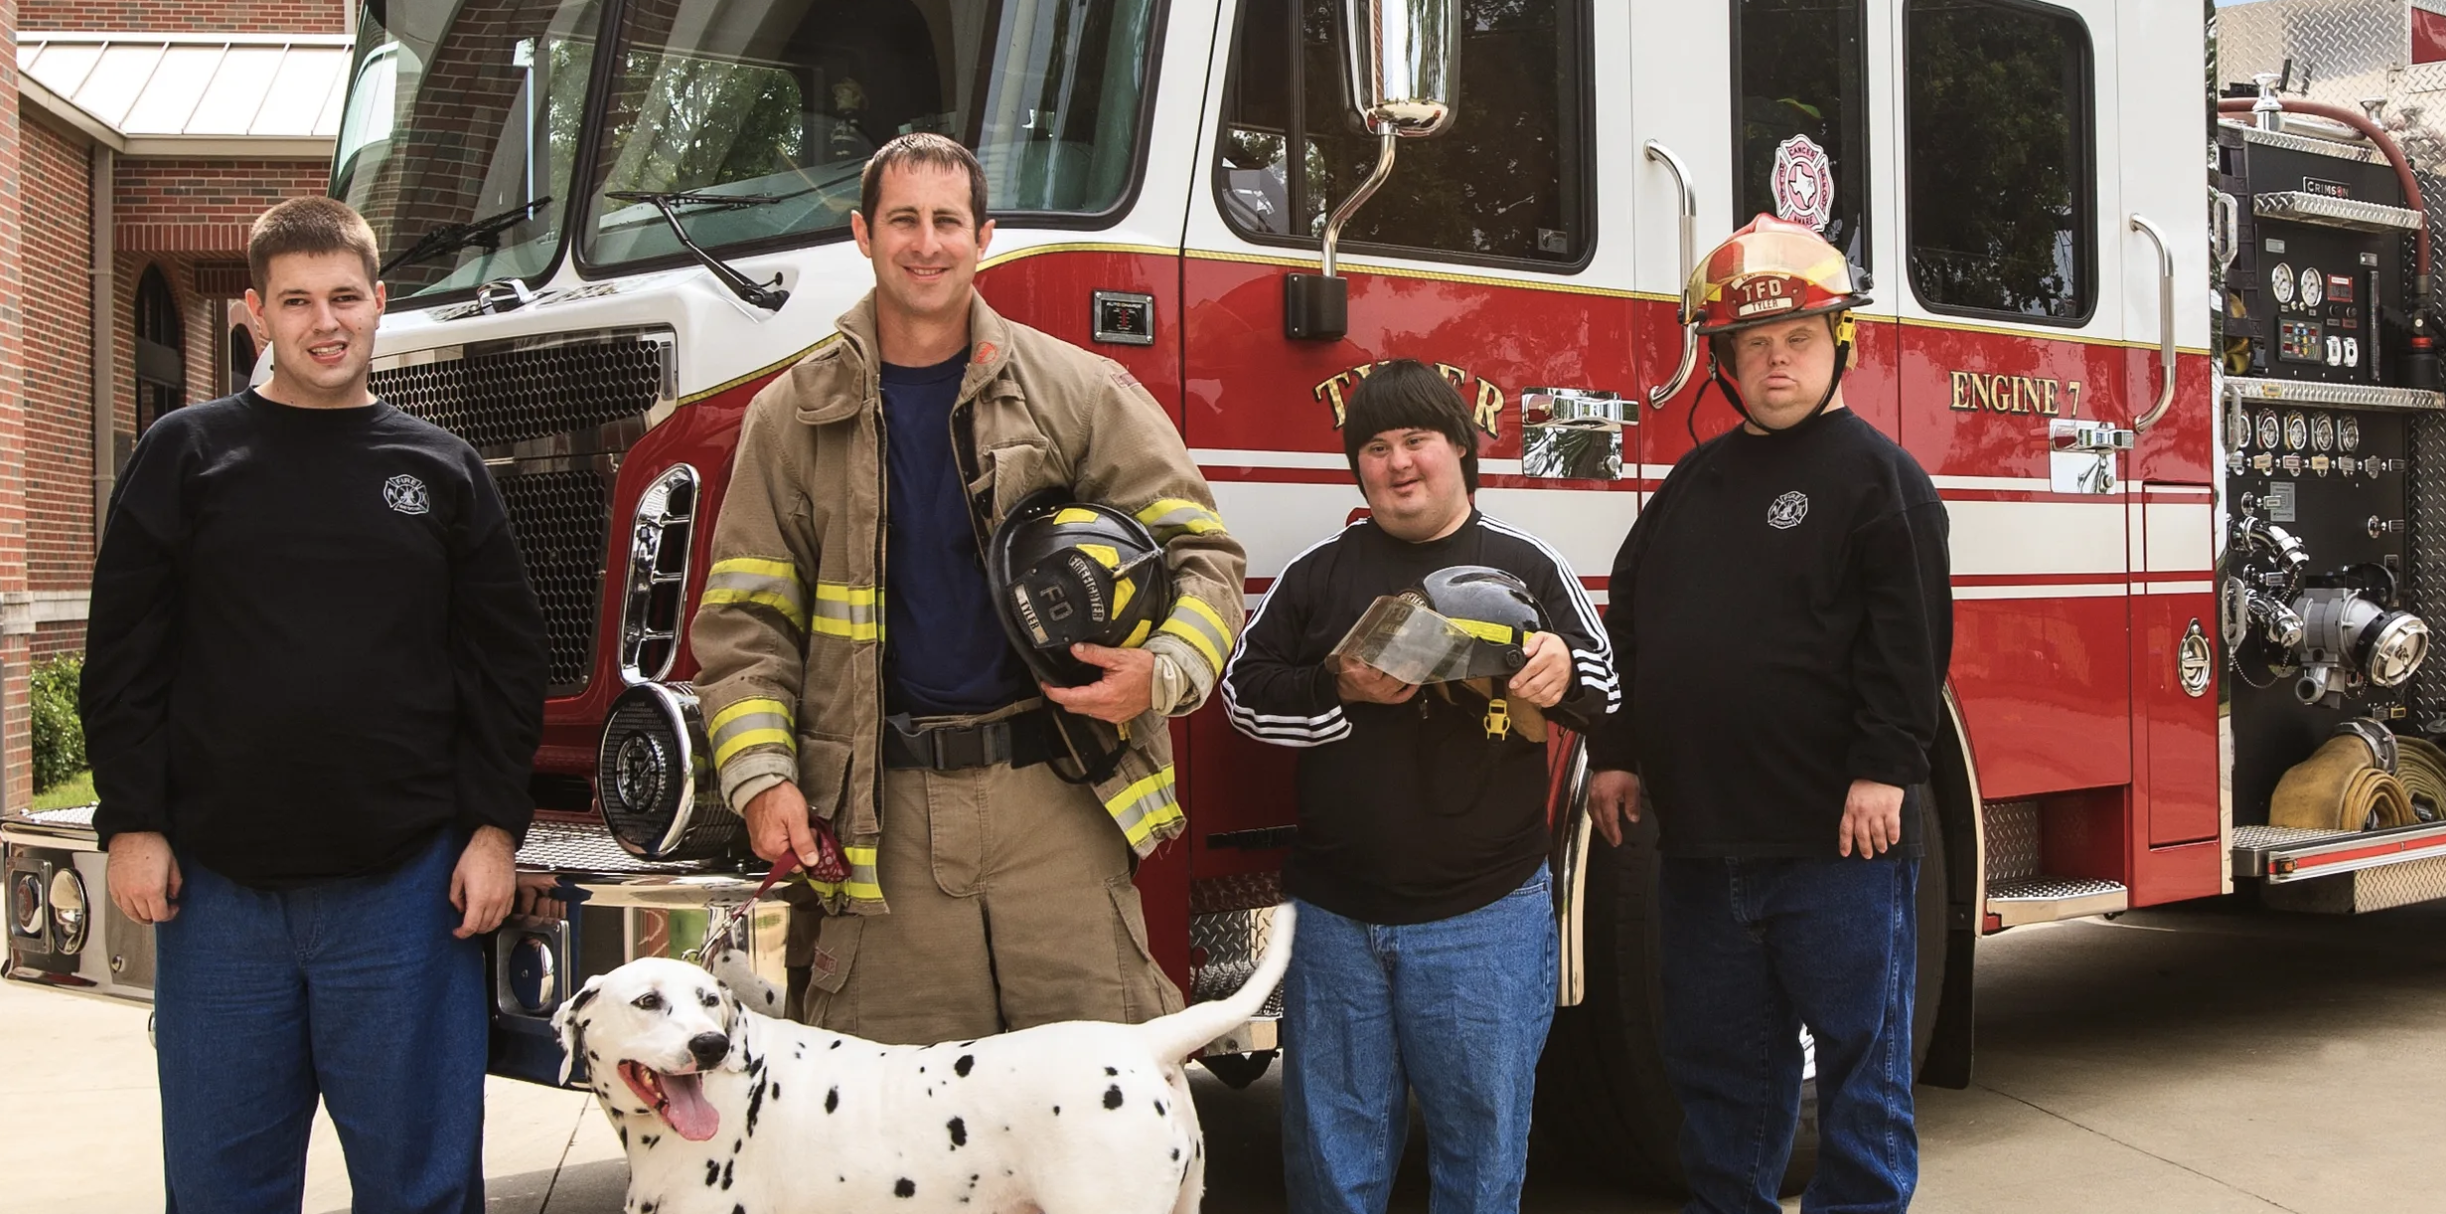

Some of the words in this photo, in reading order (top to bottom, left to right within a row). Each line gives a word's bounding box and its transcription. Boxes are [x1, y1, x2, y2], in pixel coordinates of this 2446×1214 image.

[1789, 146, 1816, 158] CANCER
[2307, 181, 2349, 197] CRIMSON
[1742, 279, 1782, 302] TFD
[1752, 299, 1778, 311] TYLER
[1950, 371, 2059, 417] ENGINE
[2068, 380, 2082, 417] 7
[1040, 584, 1074, 621] FD
[1020, 600, 1040, 630] TYLER
